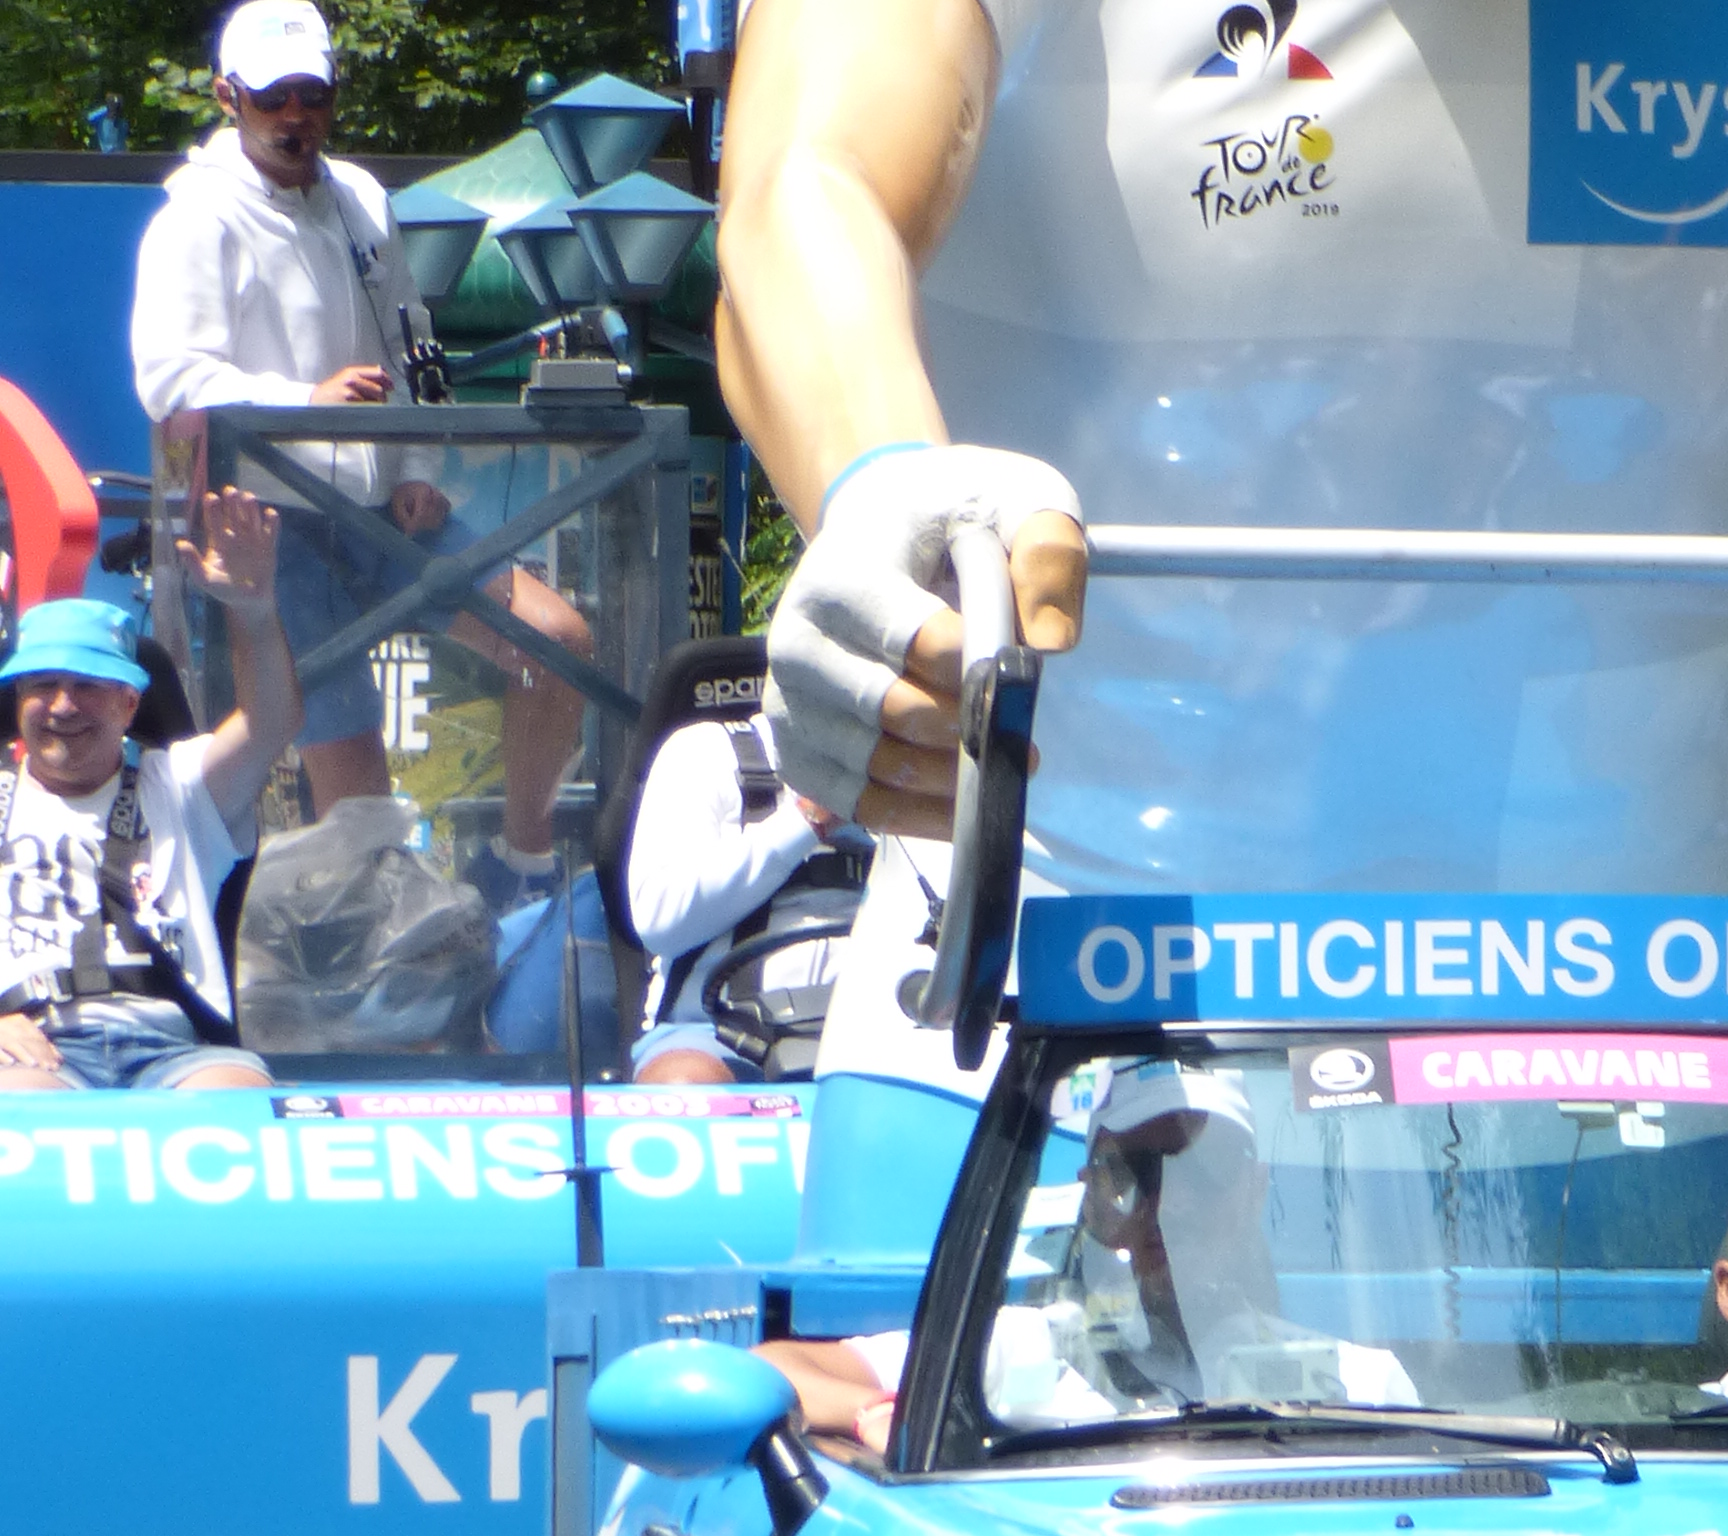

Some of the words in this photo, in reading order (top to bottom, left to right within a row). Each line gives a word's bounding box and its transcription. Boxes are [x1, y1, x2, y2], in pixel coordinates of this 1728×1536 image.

[1076, 919, 1616, 1004] OPTICIENS
[1422, 1048, 1712, 1089] CARAVANE
[361, 1094, 558, 1114] CARAVANE
